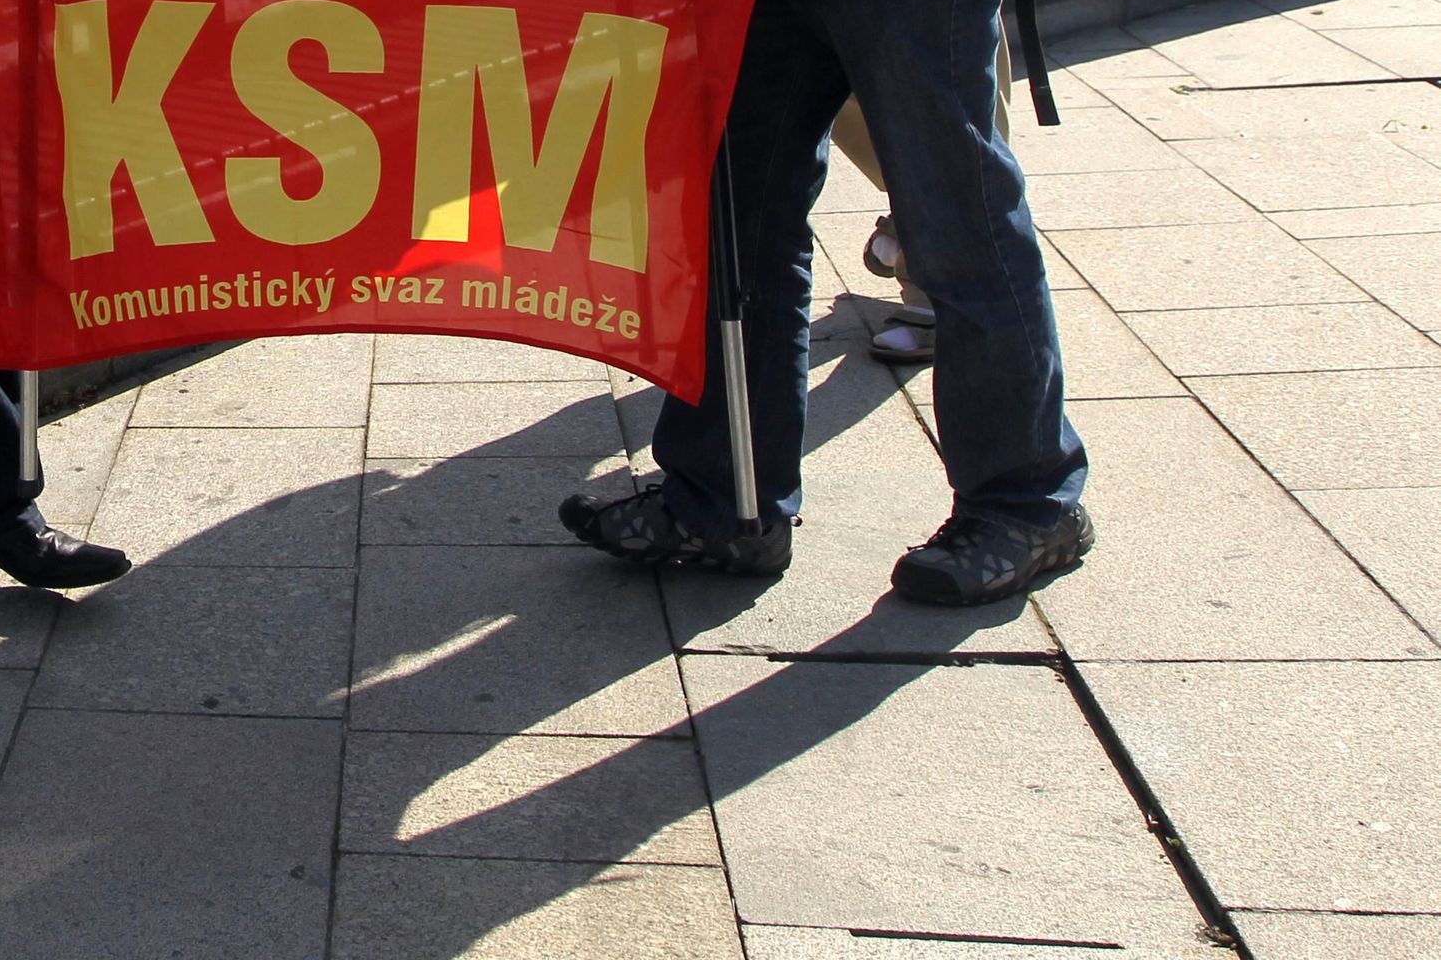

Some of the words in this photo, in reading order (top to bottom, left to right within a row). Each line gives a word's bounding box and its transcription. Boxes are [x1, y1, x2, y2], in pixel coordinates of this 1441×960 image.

[54, 0, 668, 273] KSM
[70, 269, 335, 329] Komunistický
[351, 276, 444, 304] svaz
[462, 276, 641, 339] mládeže
